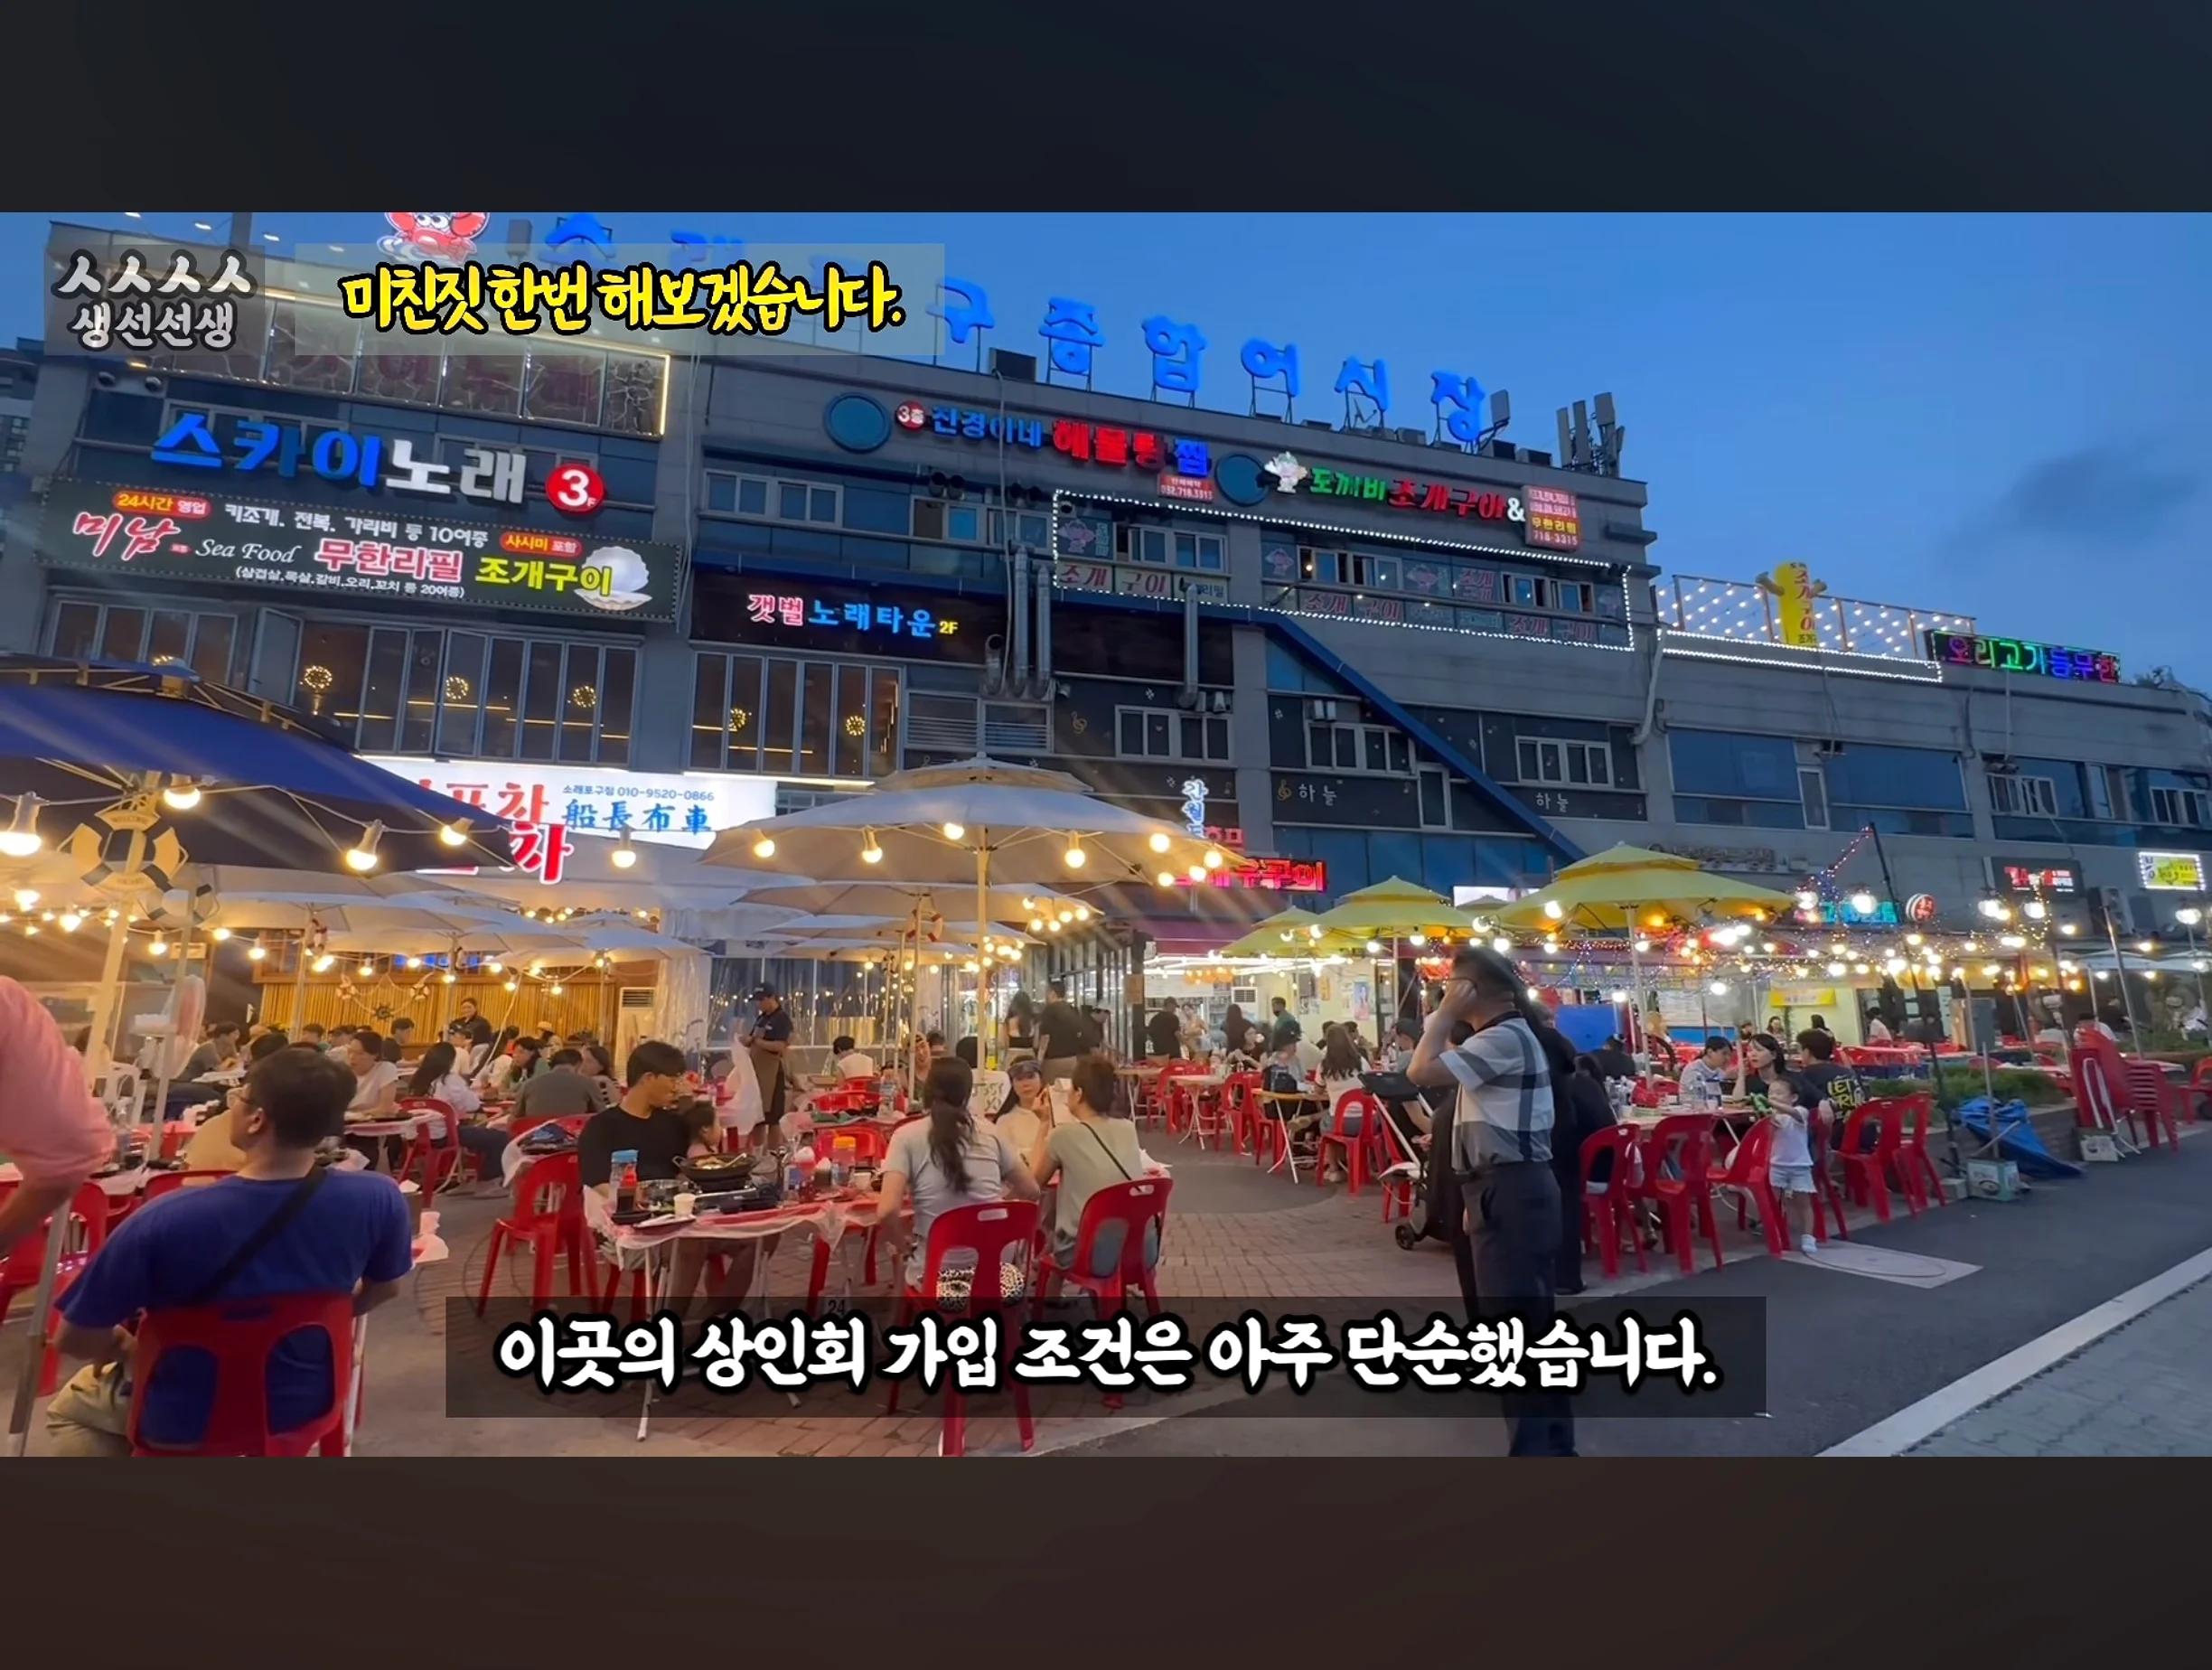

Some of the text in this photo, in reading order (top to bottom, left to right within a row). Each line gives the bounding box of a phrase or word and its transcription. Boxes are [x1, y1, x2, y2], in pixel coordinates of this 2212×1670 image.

[117, 493, 174, 512] 24시간
[344, 517, 398, 539] 가리비
[405, 523, 423, 541] 등
[429, 526, 489, 549] 10여종
[505, 533, 548, 551] 사시미
[195, 539, 235, 558] Sea
[241, 544, 302, 565] Food
[314, 537, 464, 584] 무한리필
[474, 556, 613, 597] 조개구이
[746, 594, 959, 638] 갯벌 노래타운 2F
[563, 783, 716, 802] 소래포구점 010-9520-0866
[1298, 783, 1337, 806] 하늘
[1535, 793, 1570, 812] 하늘
